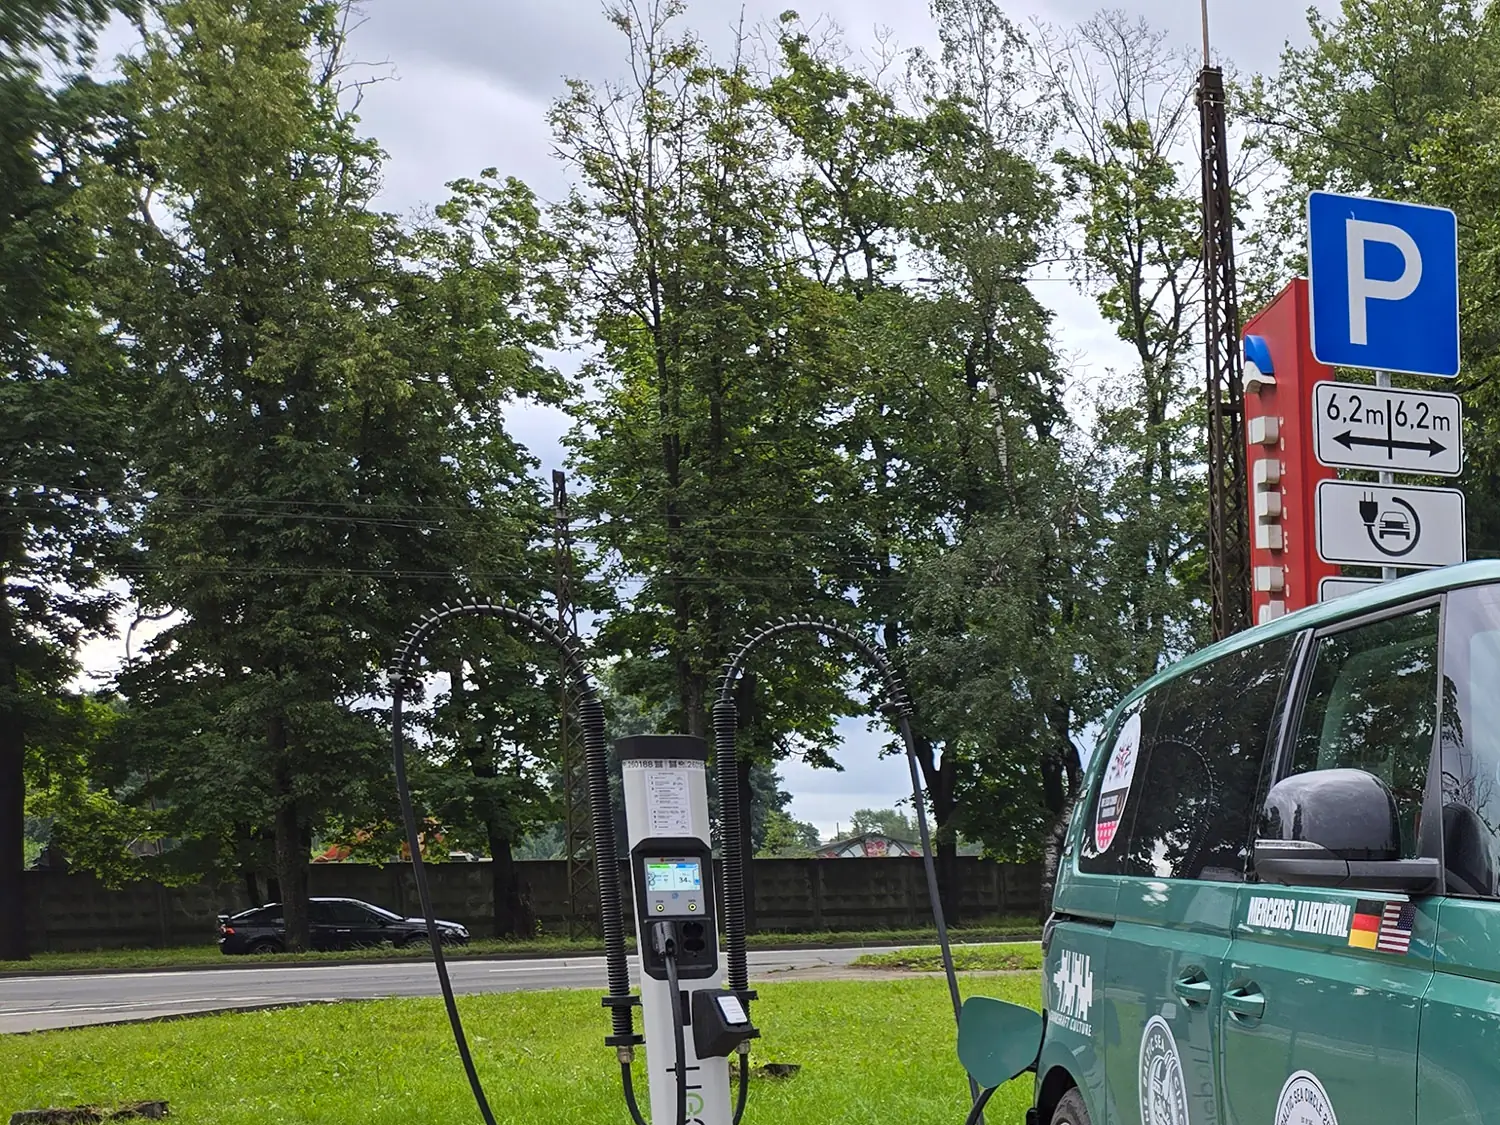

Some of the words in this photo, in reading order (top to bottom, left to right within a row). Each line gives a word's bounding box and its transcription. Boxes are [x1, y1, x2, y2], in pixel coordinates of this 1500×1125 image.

[1345, 218, 1423, 346] P
[1326, 392, 1384, 425] 6,2m
[1394, 400, 1450, 432] 6,2m
[1246, 896, 1296, 931] MERCEDES
[1294, 900, 1352, 938] LILIENTHAL
[1153, 1033, 1166, 1053] SEA
[1293, 1087, 1305, 1104] SEA
